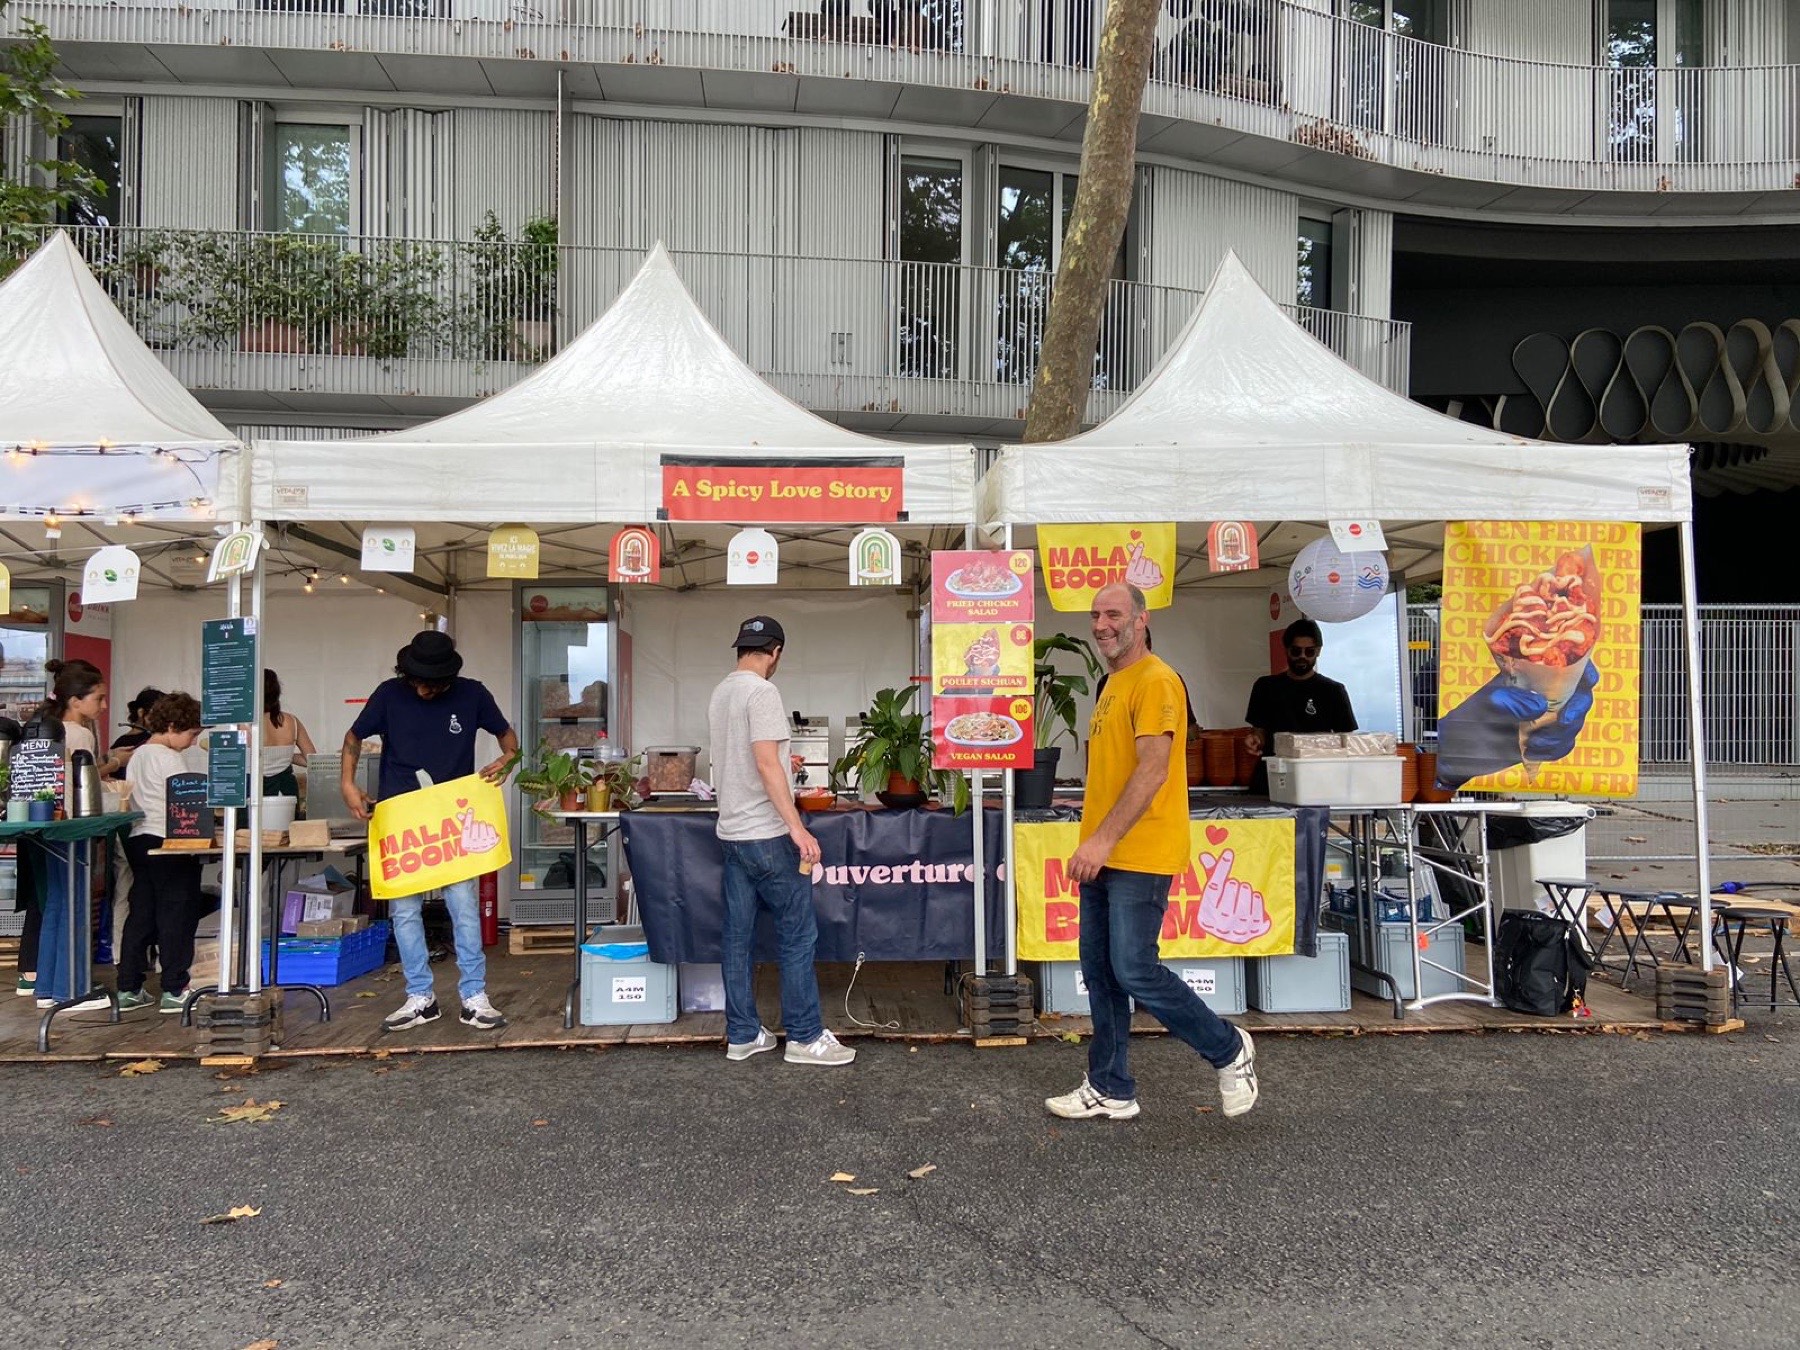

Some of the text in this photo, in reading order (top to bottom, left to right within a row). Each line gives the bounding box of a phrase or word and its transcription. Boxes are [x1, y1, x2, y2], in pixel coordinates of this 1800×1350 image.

[672, 479, 892, 502] A Spicy Love Story
[1539, 522, 1627, 543] FRIED
[1049, 546, 1128, 567] MALA
[1050, 568, 1128, 588] BOOM
[967, 608, 998, 616] SALAD
[977, 600, 1019, 608] CHICKEN
[942, 678, 1023, 686] POULET SICHUAN
[21, 740, 50, 751] MENU
[379, 817, 461, 860] MALA
[381, 837, 469, 881] BOOM
